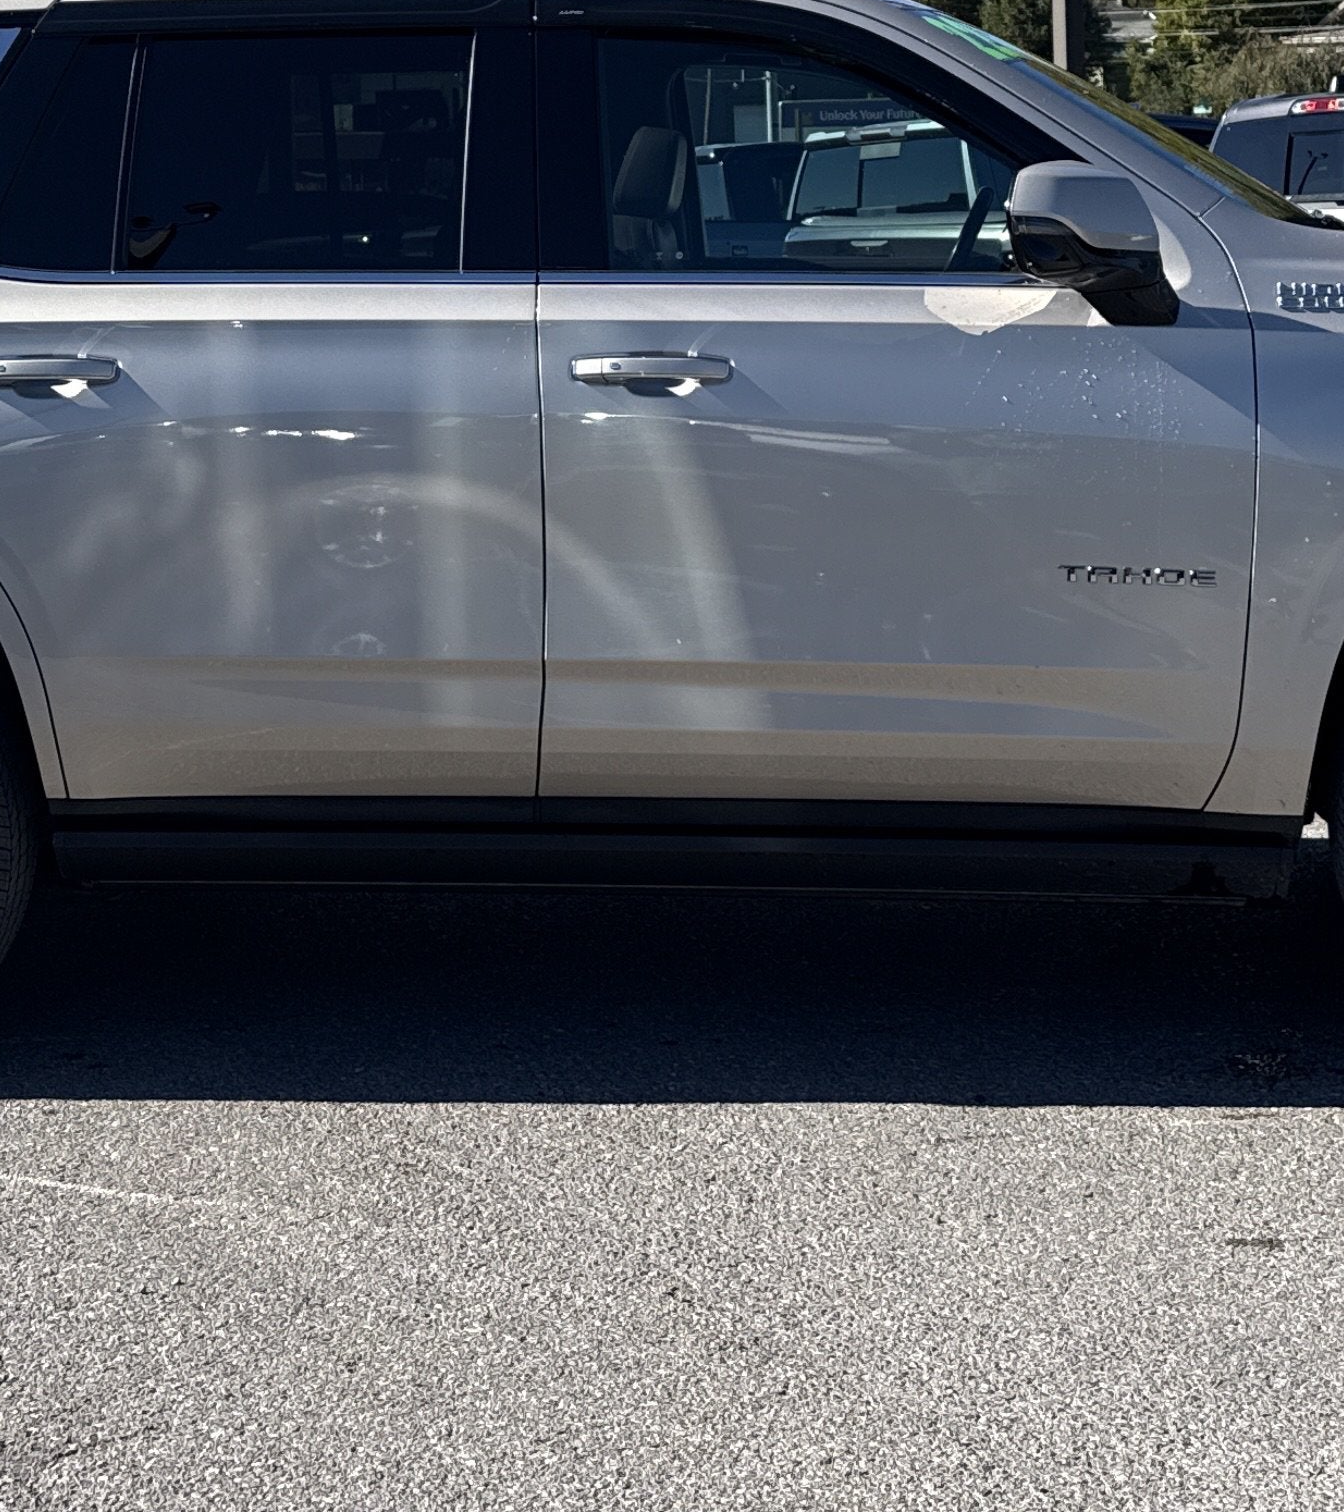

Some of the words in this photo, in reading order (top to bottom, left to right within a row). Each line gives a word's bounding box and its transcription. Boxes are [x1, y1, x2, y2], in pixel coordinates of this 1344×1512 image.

[819, 110, 858, 121] Unlock
[859, 110, 885, 120] Your
[1057, 564, 1217, 588] TAHOE
